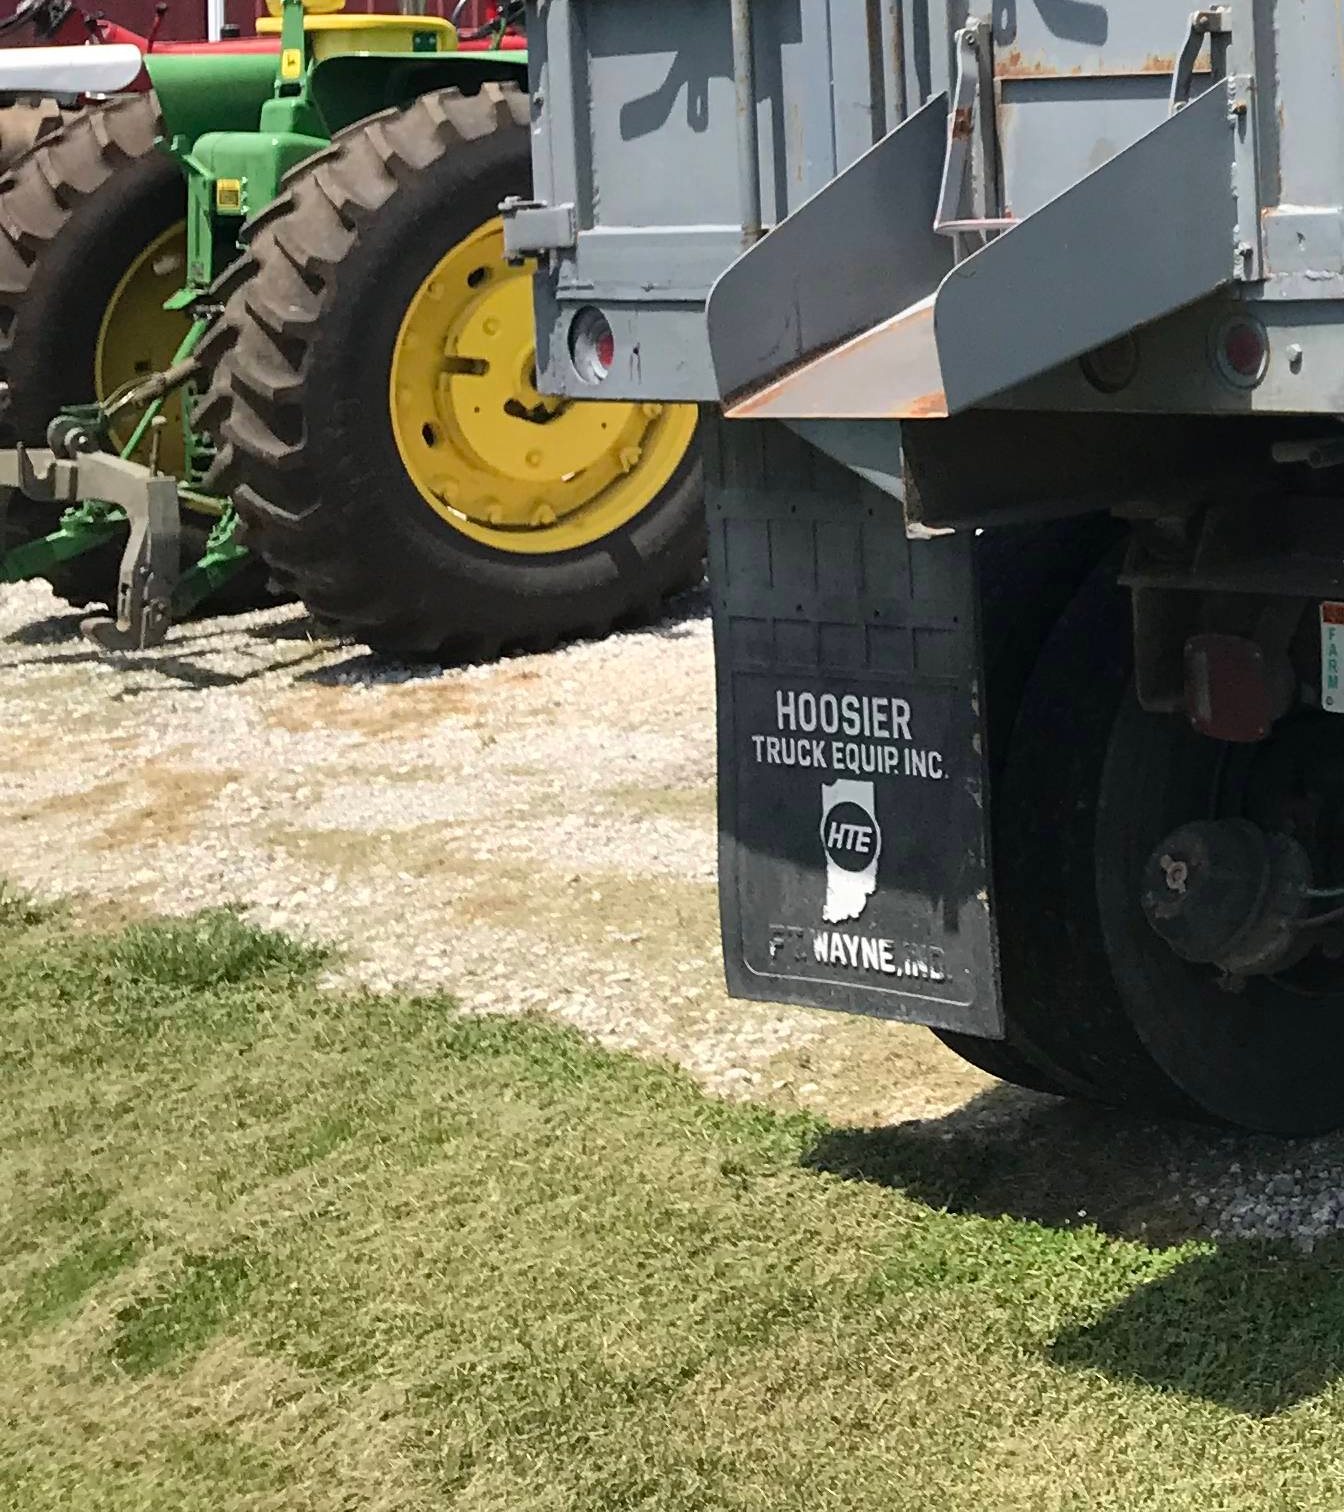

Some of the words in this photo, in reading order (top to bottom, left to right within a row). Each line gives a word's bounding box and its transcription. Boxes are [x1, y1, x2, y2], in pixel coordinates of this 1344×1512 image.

[1327, 627, 1339, 690] FARM
[776, 689, 912, 740] HOOSIER
[752, 735, 828, 768] TRUCK
[832, 742, 899, 776] EQUIP.
[904, 748, 949, 779] INC.
[827, 821, 873, 854] HTE
